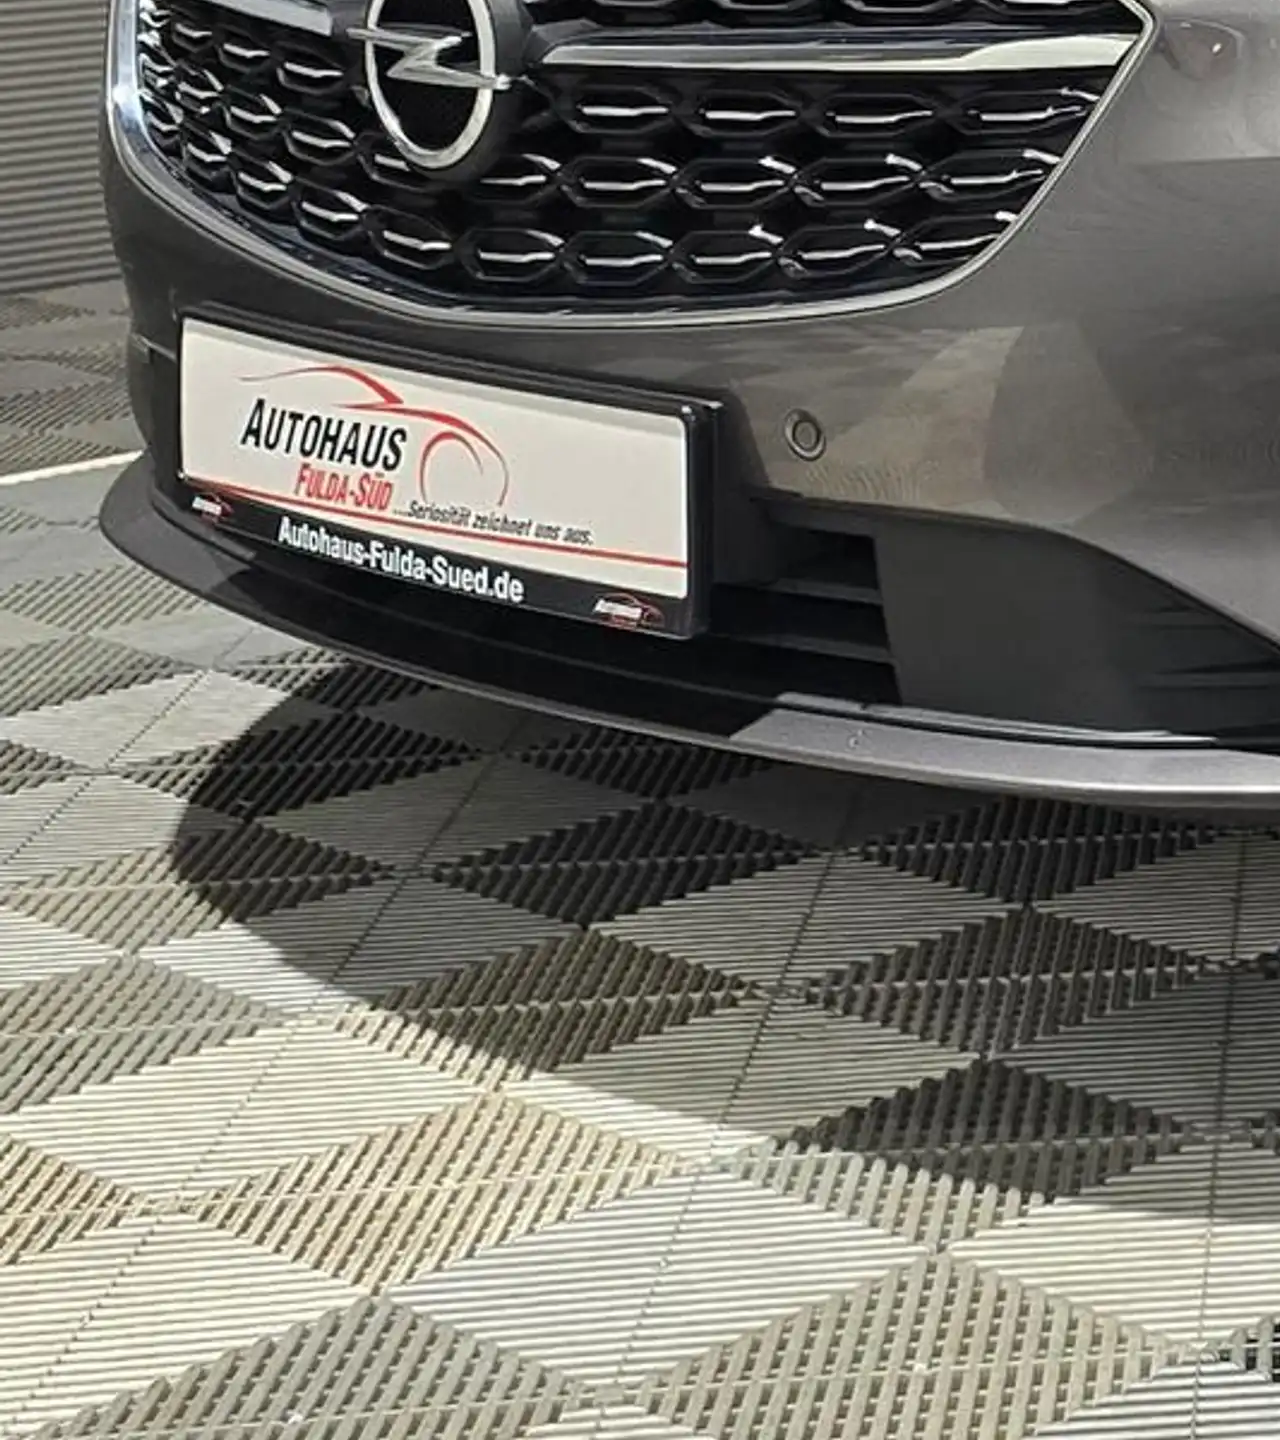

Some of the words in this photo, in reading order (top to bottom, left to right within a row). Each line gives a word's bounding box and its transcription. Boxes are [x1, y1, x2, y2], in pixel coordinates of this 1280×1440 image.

[240, 397, 408, 472] AUTOHAUS
[294, 462, 396, 512] FULDA-SÜD
[473, 511, 533, 537] zeichnet
[534, 522, 561, 541] uns
[277, 515, 525, 604] Autohaus-Fulda-Sued.de
